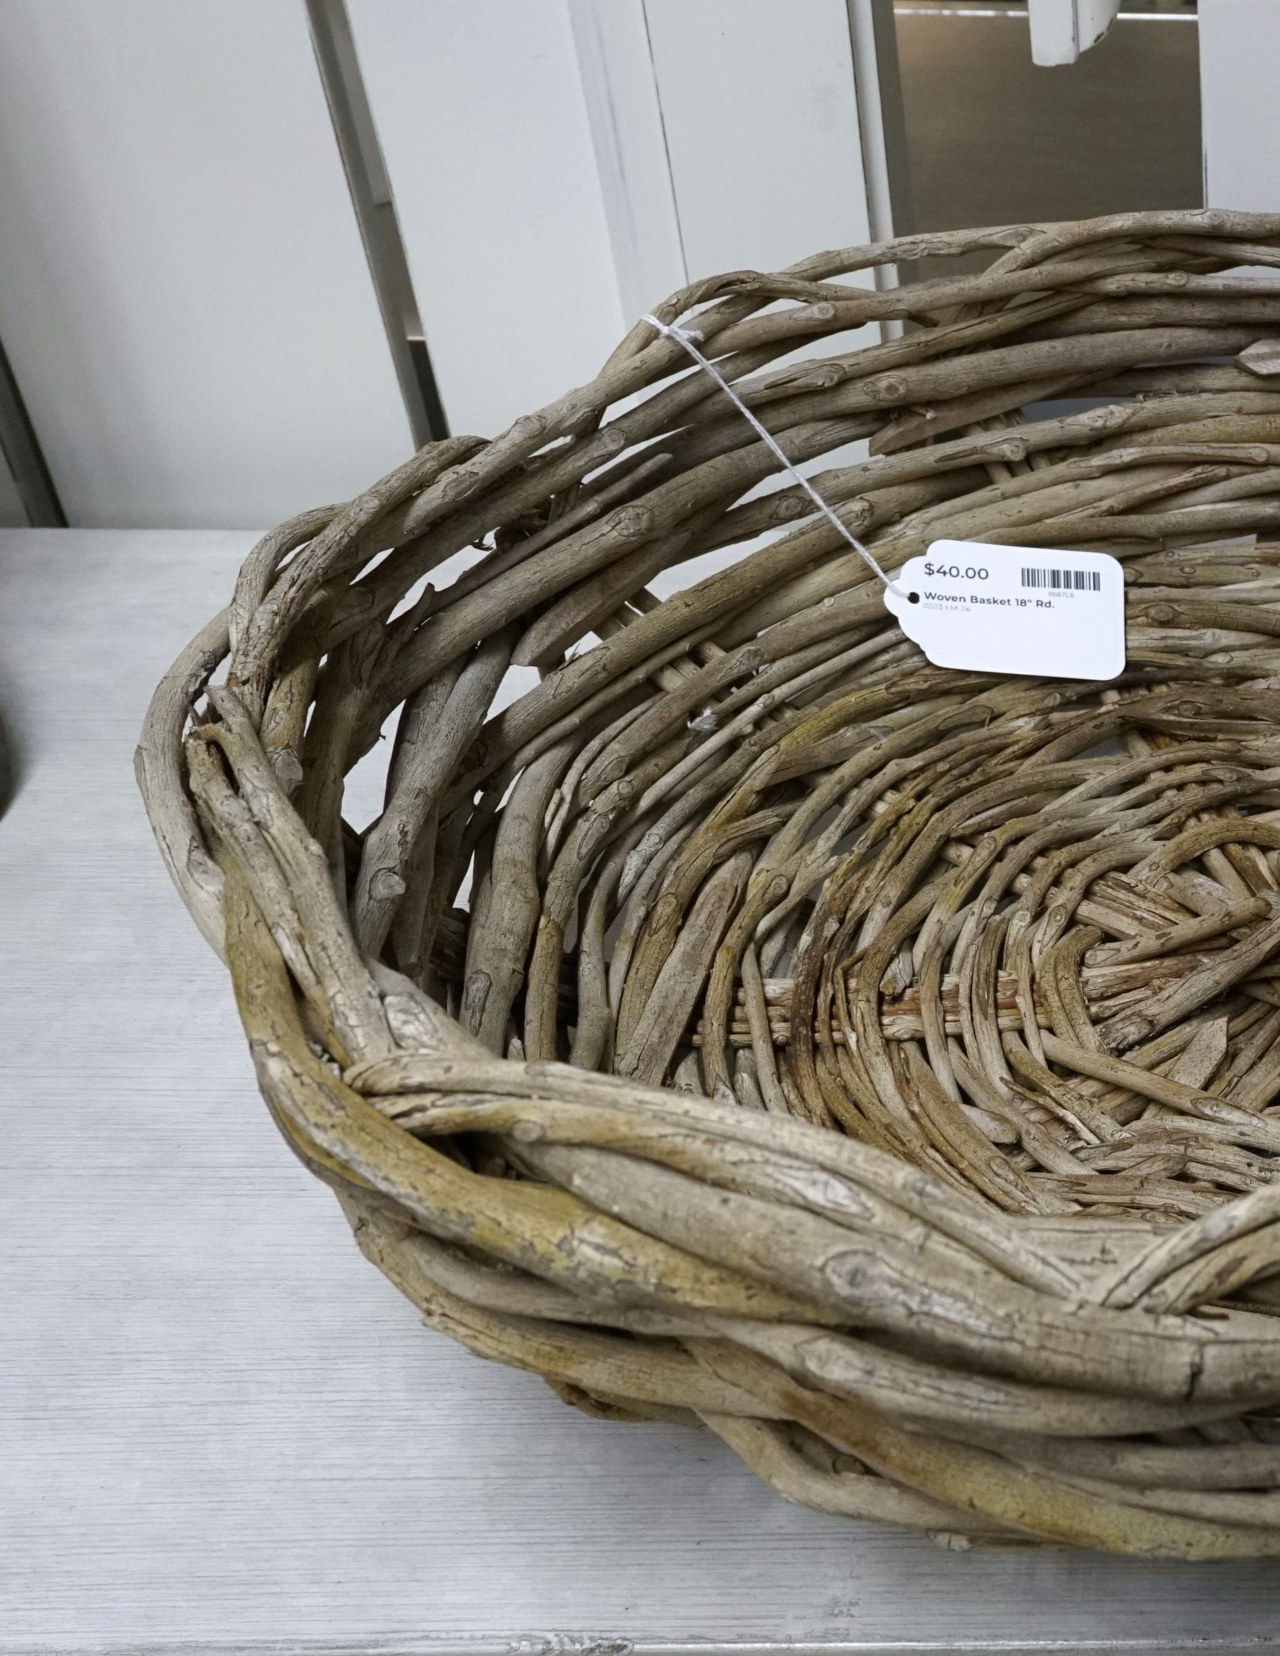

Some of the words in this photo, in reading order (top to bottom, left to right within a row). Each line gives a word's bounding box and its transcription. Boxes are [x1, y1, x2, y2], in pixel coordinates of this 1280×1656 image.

[924, 562, 990, 580] $40.00
[924, 591, 967, 603] Woven
[970, 595, 1012, 607] Basket
[1015, 598, 1033, 608] 18"
[1036, 599, 1056, 609] Rd.
